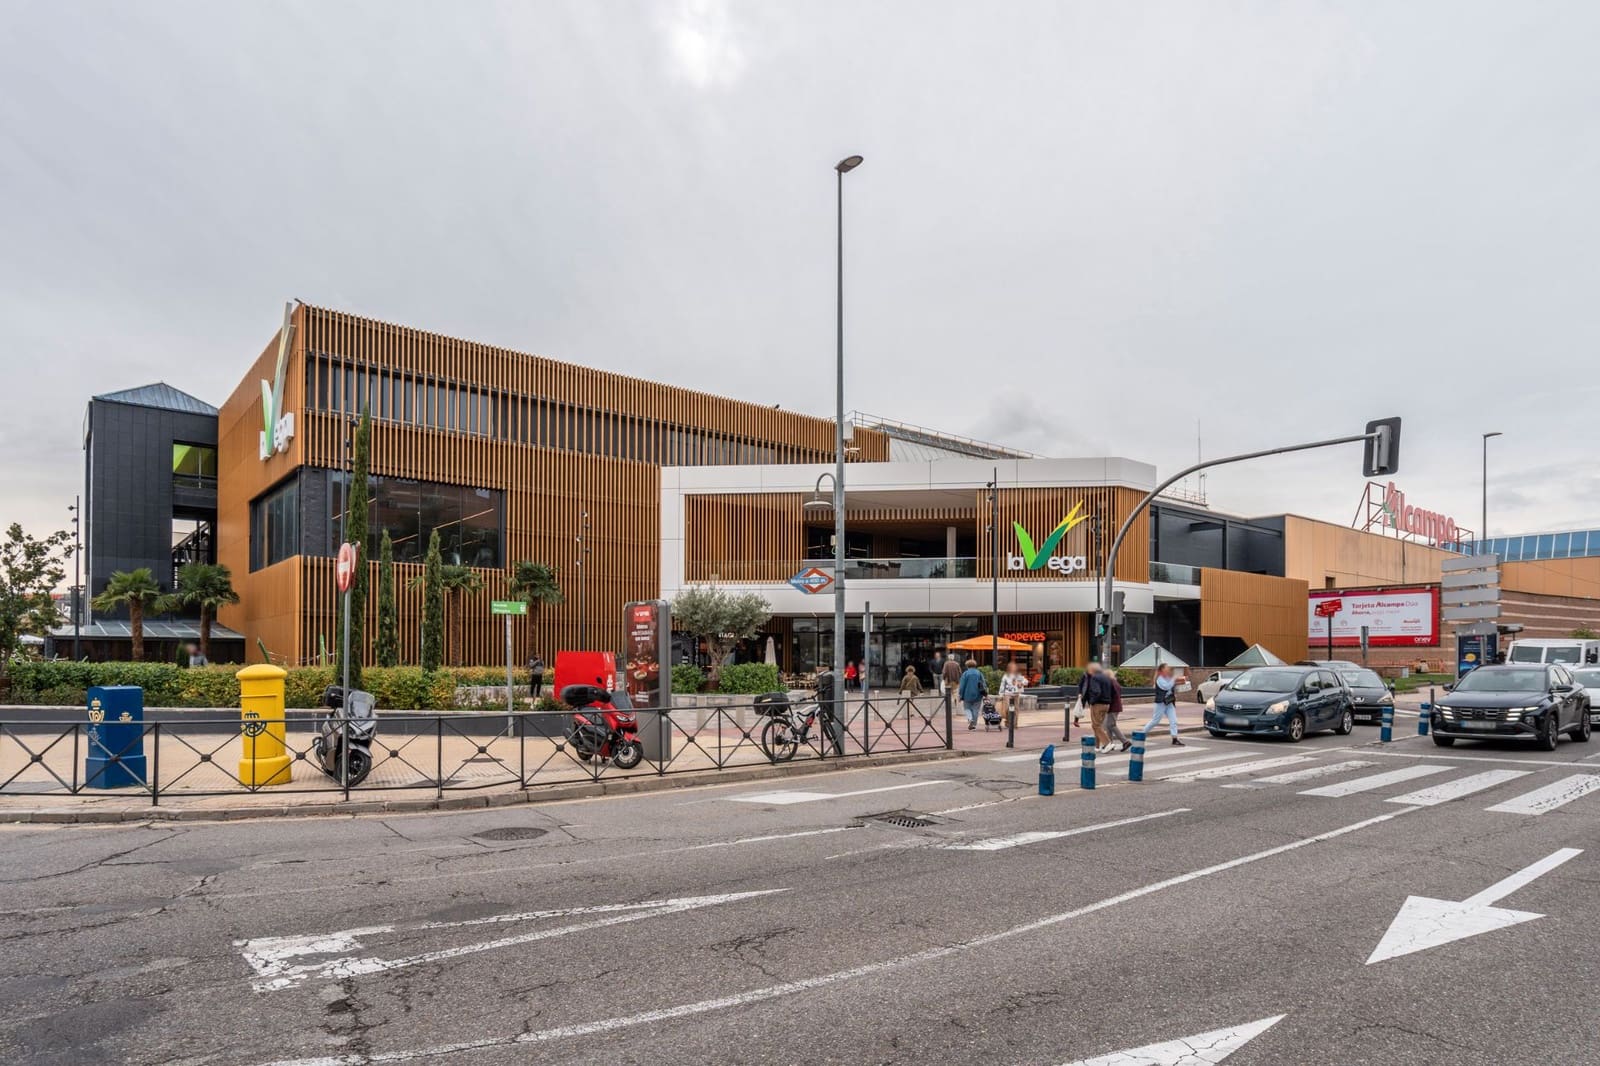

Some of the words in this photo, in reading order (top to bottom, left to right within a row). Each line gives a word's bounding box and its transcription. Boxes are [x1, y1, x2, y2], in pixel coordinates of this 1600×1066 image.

[1382, 481, 1456, 547] Alcampo
[1007, 552, 1024, 571] la
[1376, 601, 1405, 609] Alcampo
